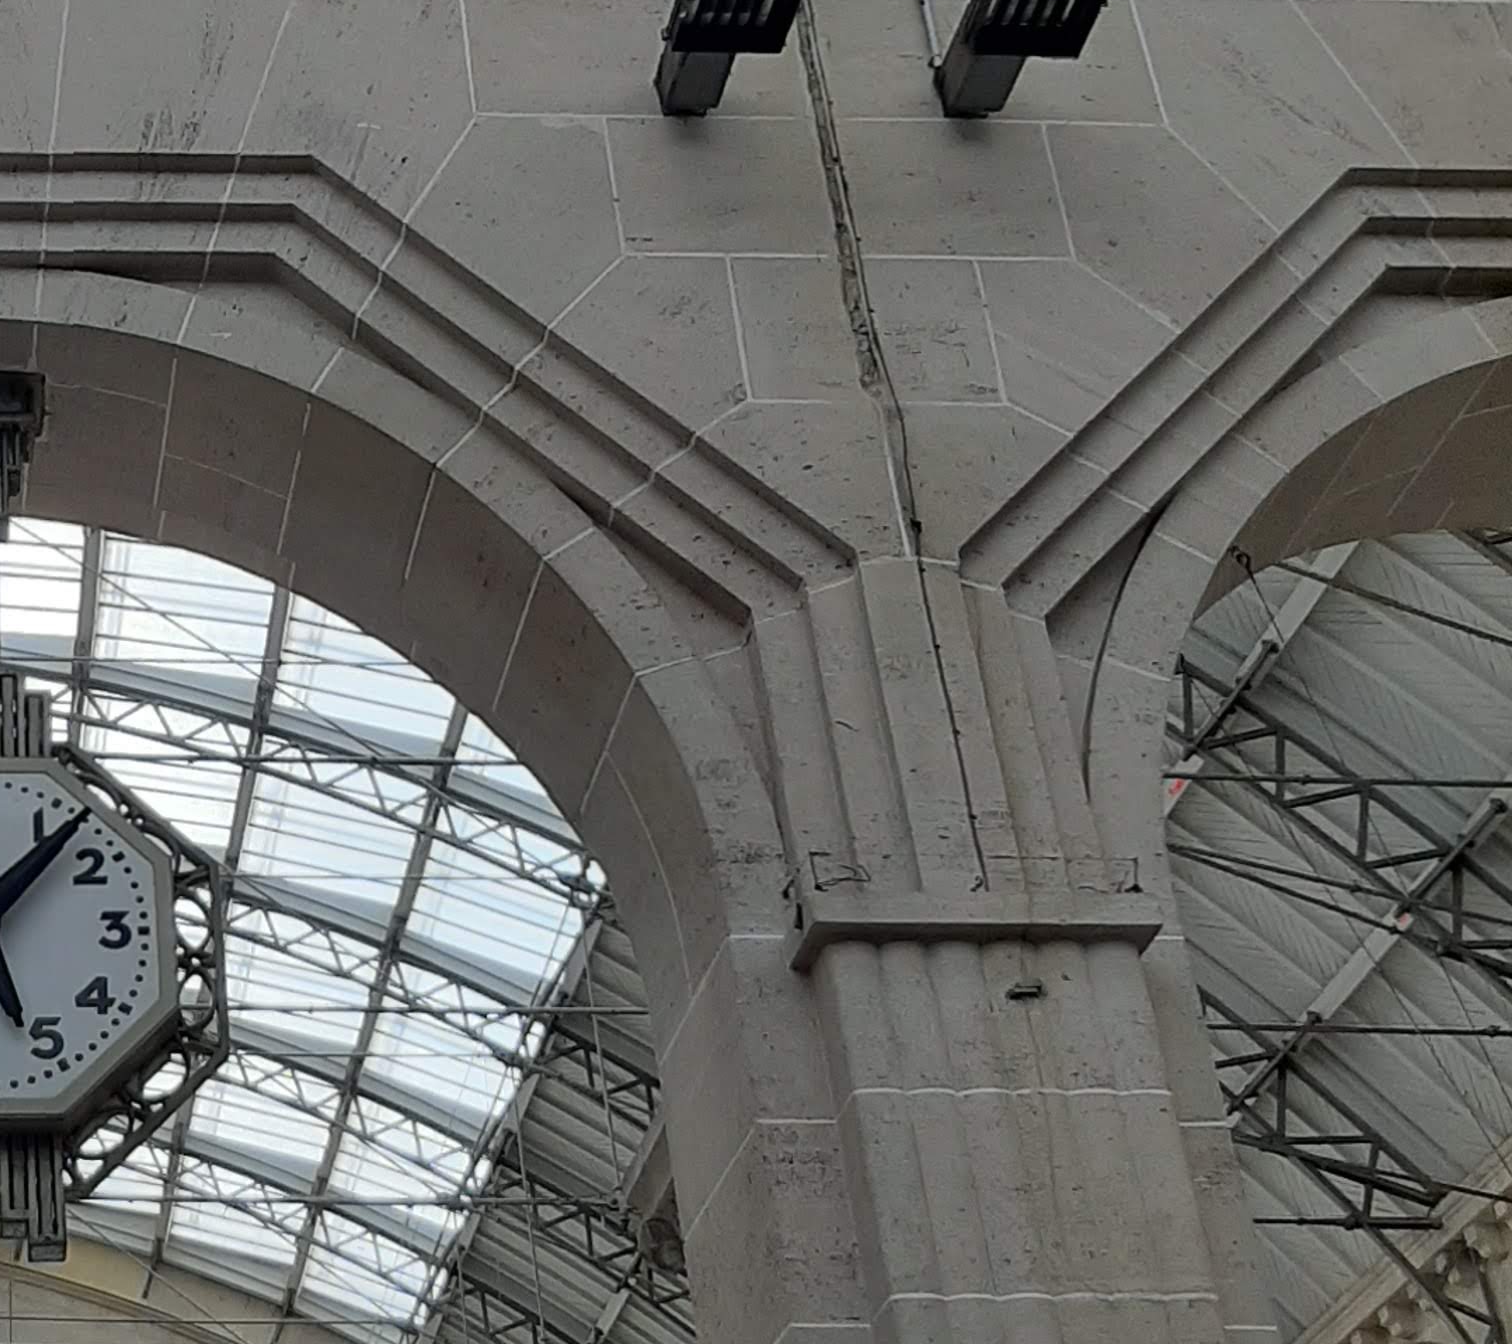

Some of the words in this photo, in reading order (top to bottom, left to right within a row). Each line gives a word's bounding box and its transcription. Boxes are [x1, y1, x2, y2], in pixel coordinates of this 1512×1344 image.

[33, 807, 45, 844] 1
[72, 847, 109, 886] 2
[98, 910, 133, 950] 3
[73, 976, 117, 1015] 4
[28, 1016, 65, 1060] 5
